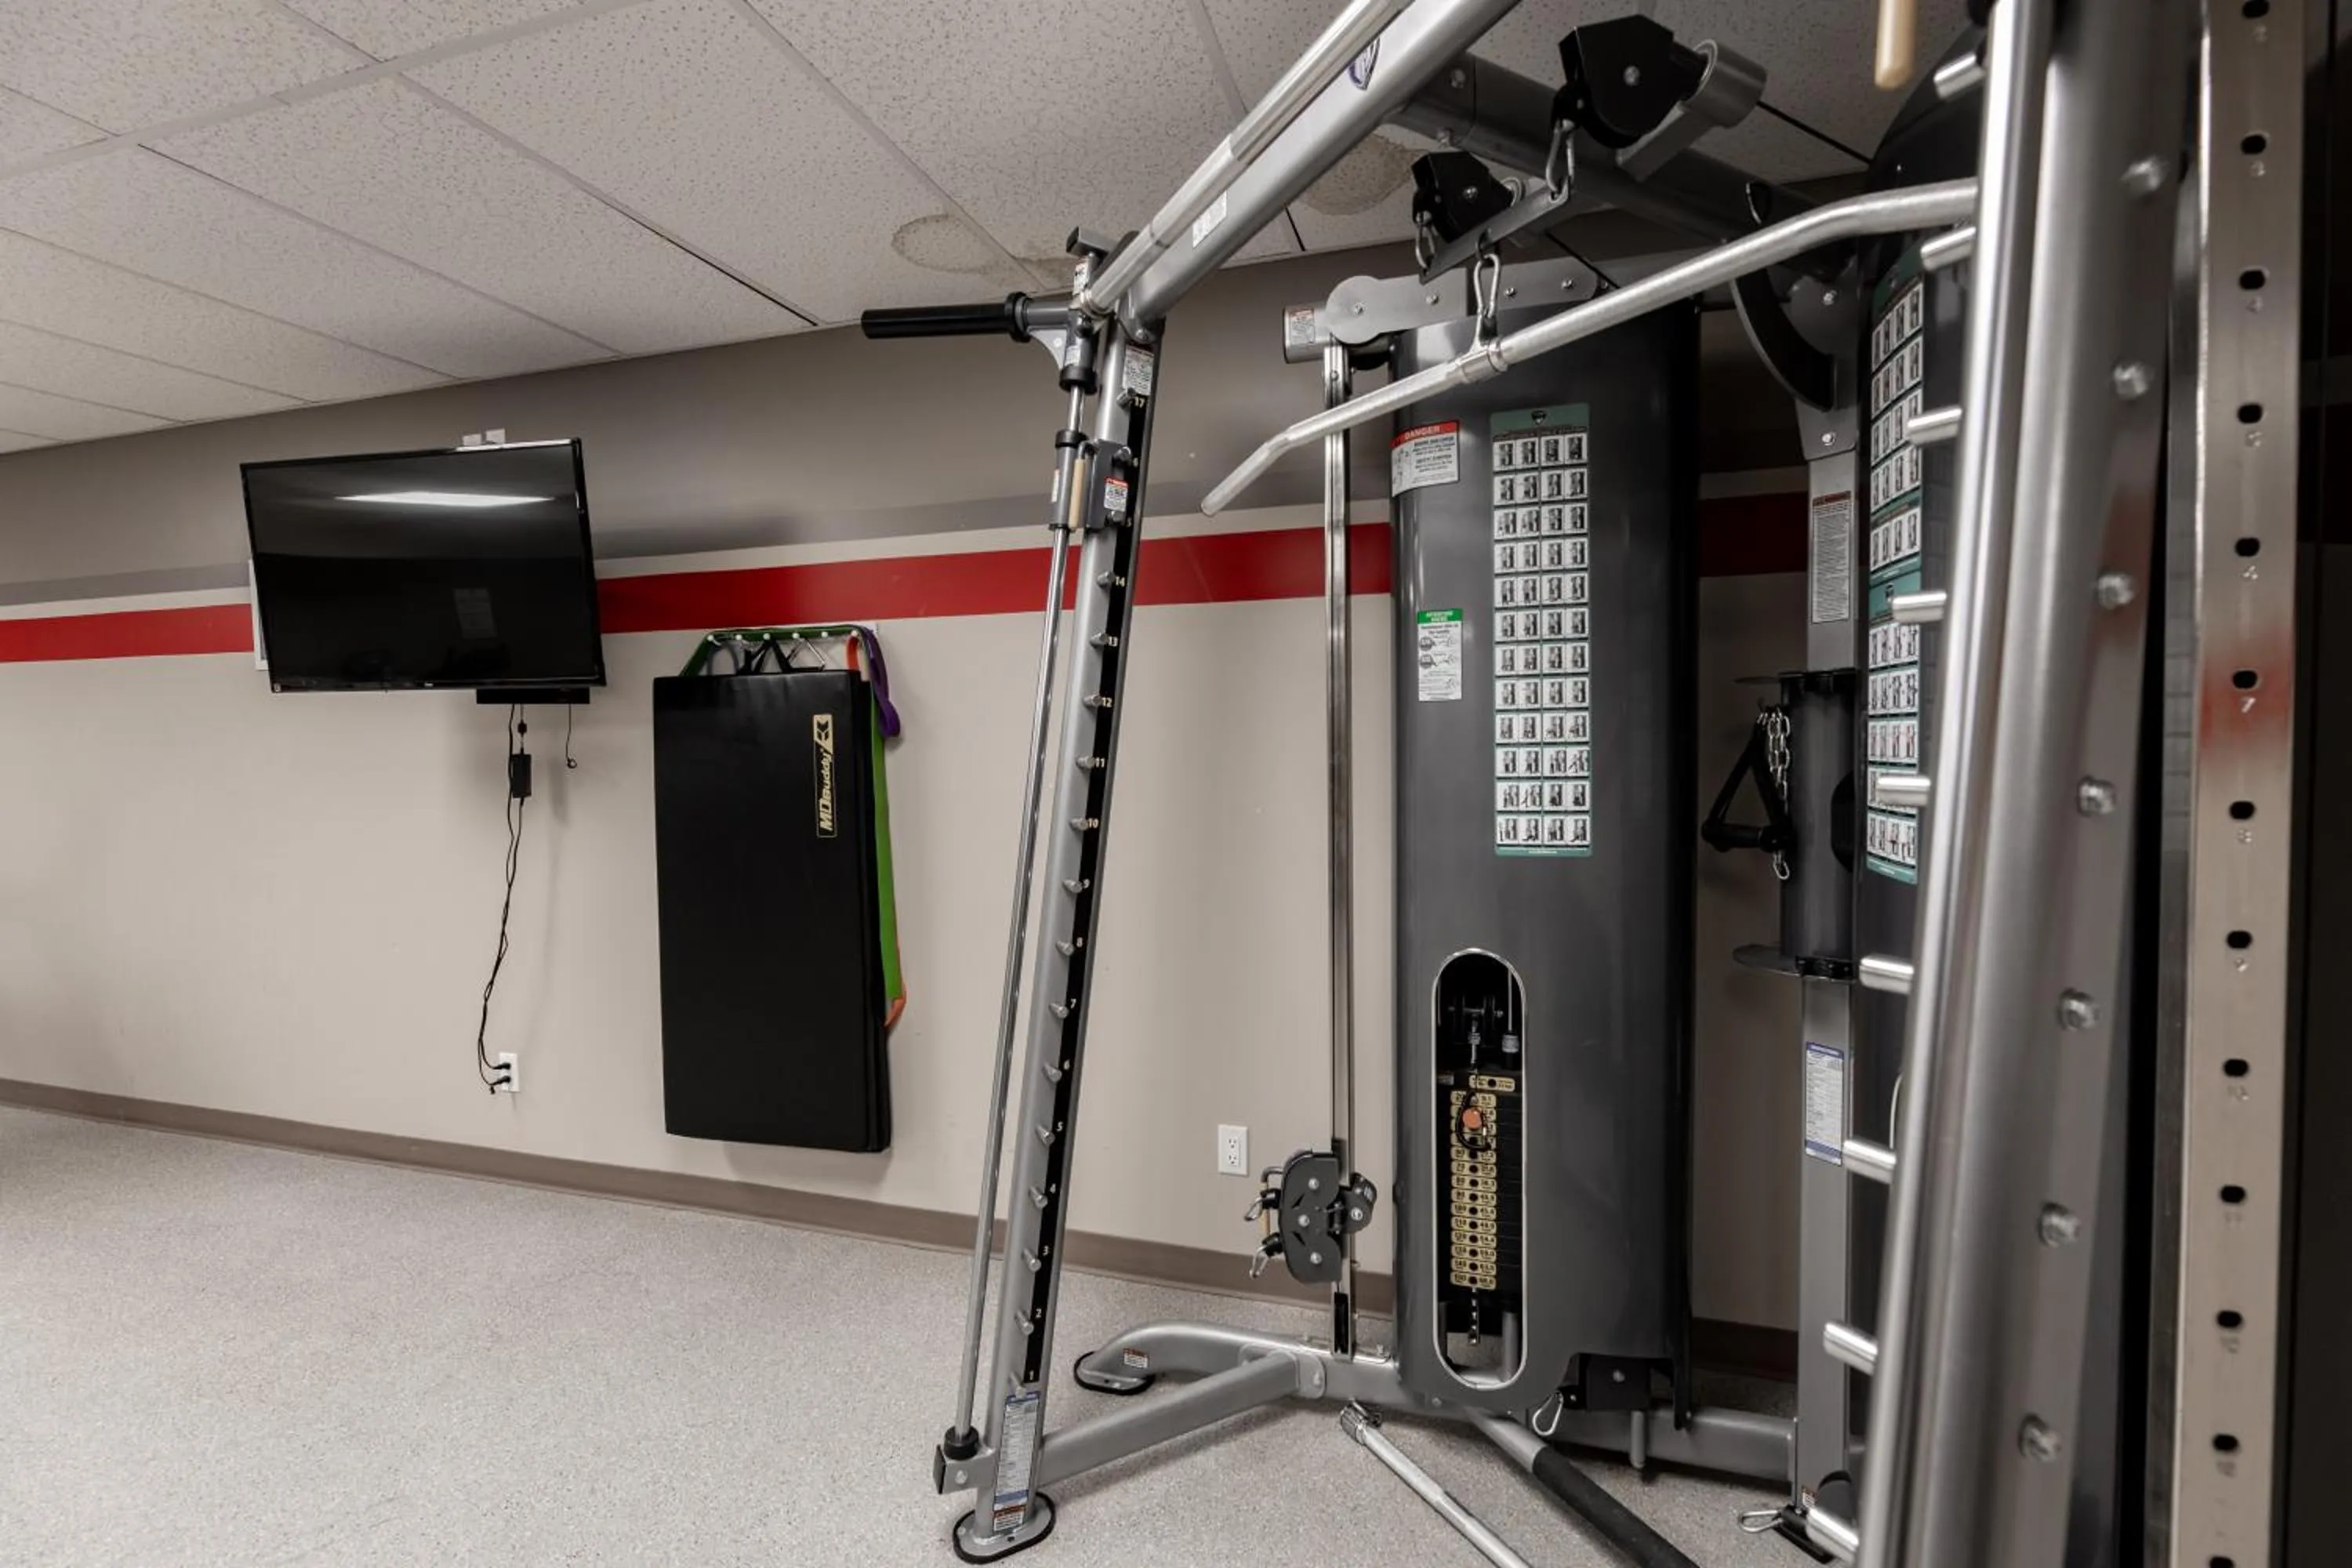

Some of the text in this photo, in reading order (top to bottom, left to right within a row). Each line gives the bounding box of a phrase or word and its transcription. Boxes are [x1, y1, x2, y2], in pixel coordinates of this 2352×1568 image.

[1134, 396, 1145, 408] 17
[1405, 426, 1439, 439] DANGER
[1109, 636, 1119, 647] 13
[1102, 697, 1112, 707] 12
[2241, 696, 2256, 713] 7
[1094, 757, 1105, 768] 11
[1088, 818, 1099, 828] 10
[1076, 937, 1083, 948] 8
[1070, 998, 1076, 1009] 7
[1063, 1060, 1070, 1070] 6
[1056, 1121, 1063, 1132] 5
[1050, 1183, 1056, 1193] 4
[1043, 1245, 1049, 1256] 3
[1035, 1308, 1042, 1318] 2
